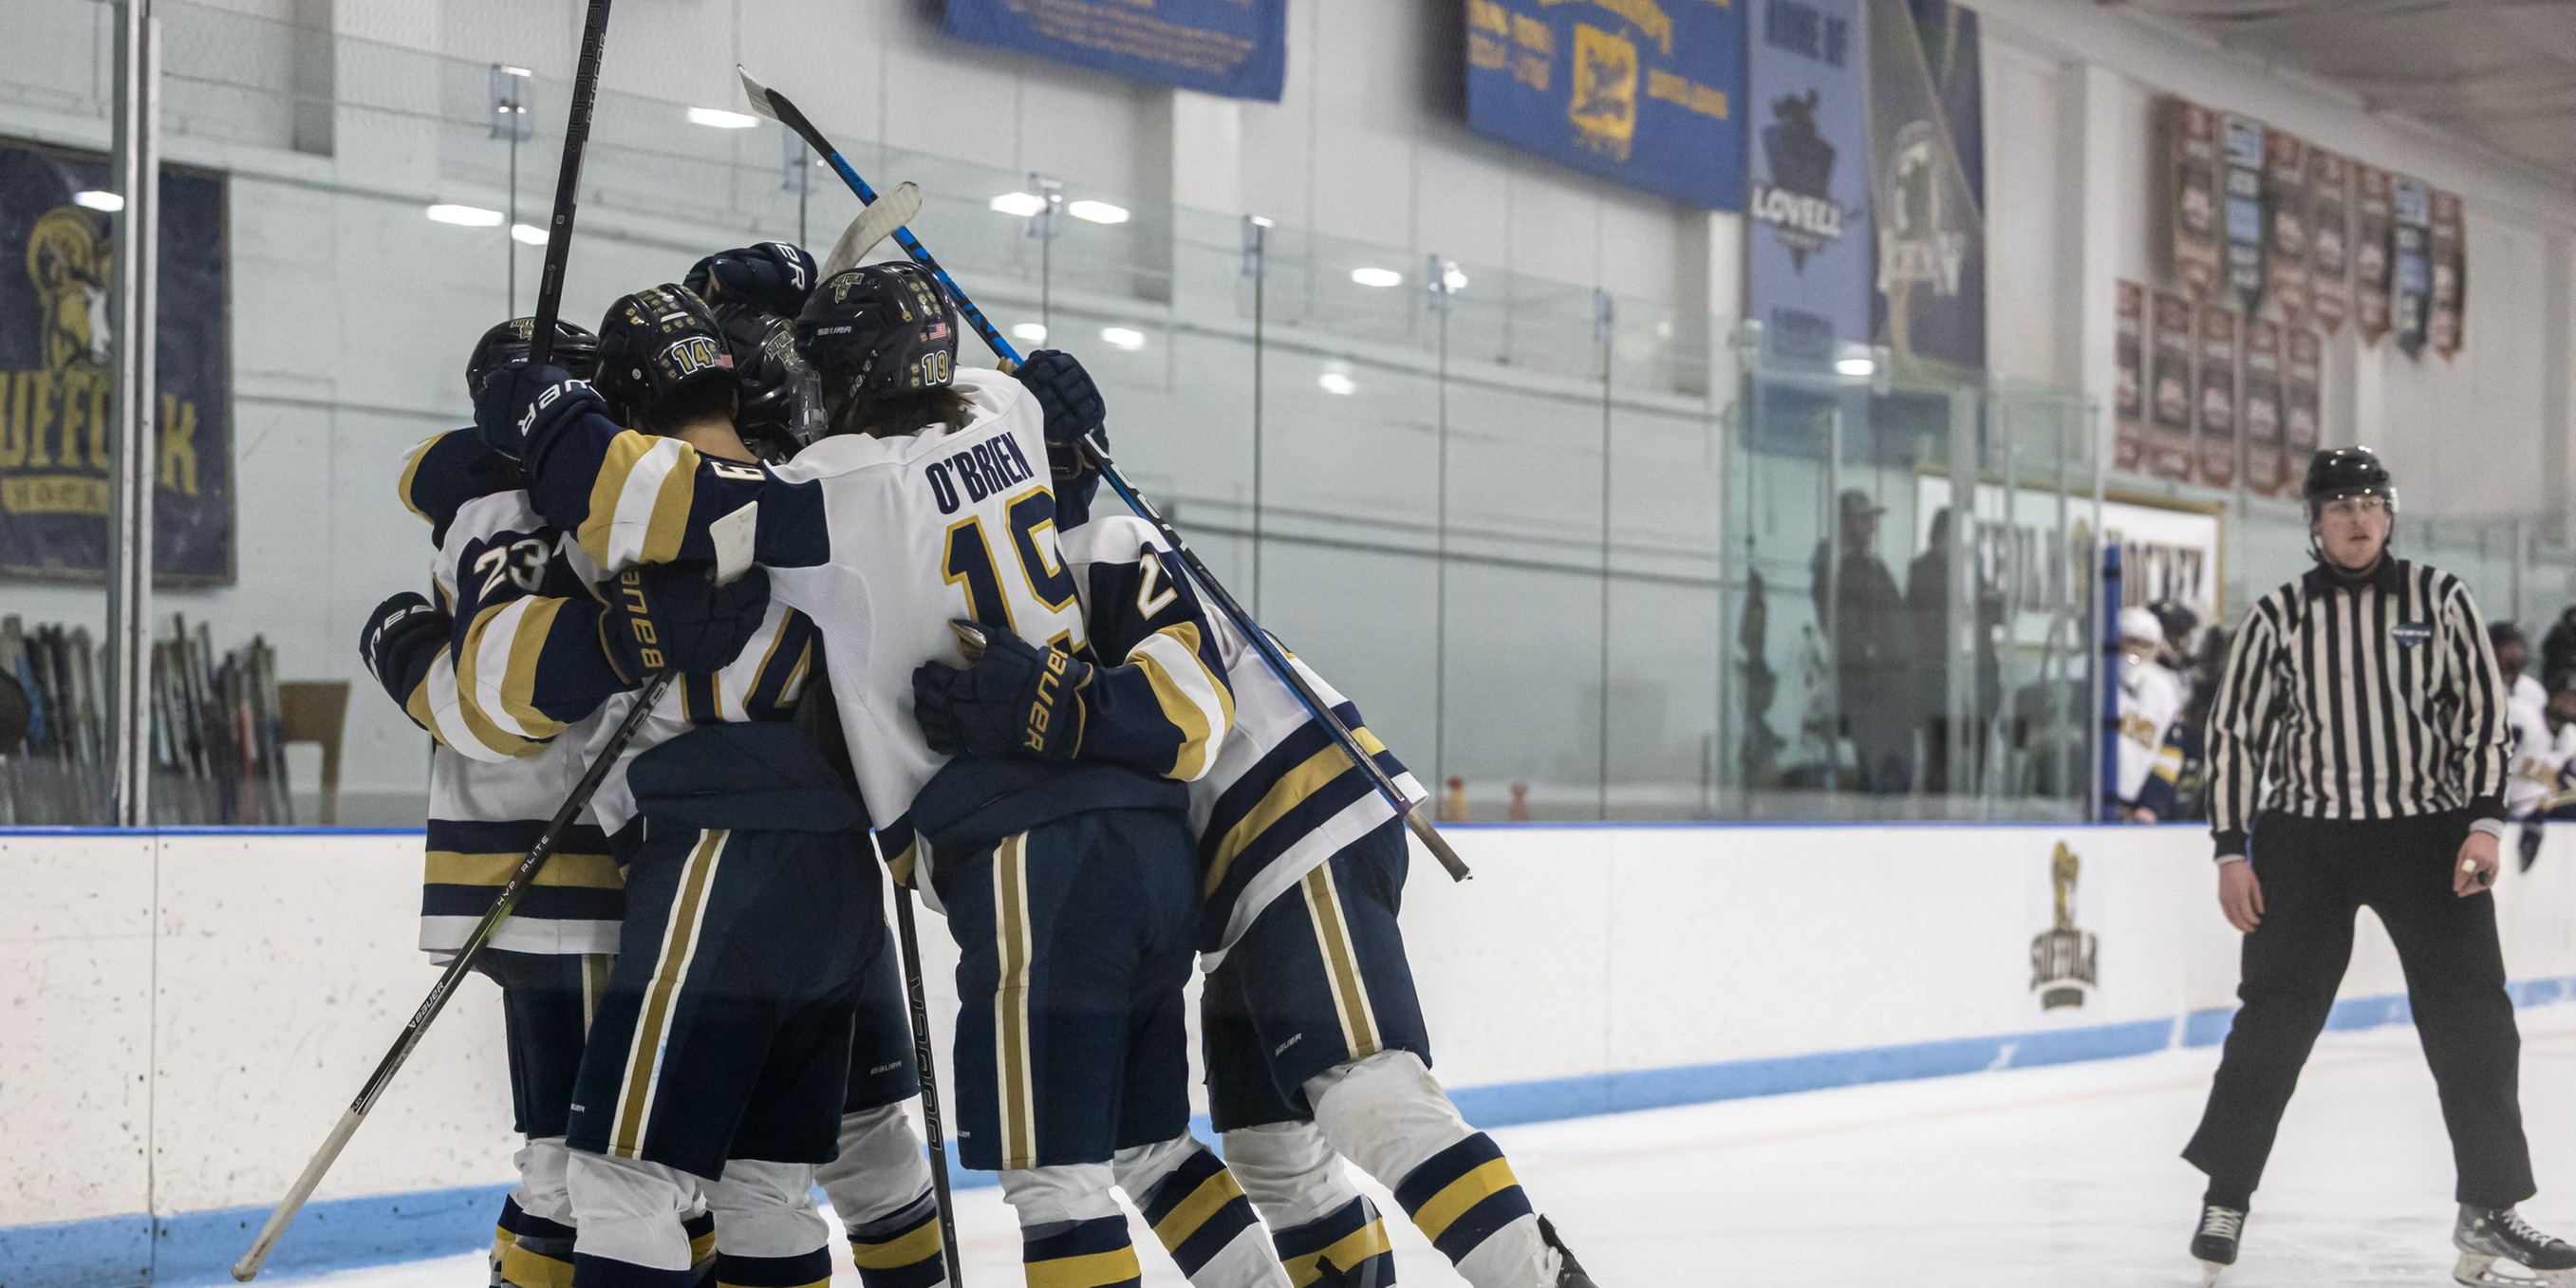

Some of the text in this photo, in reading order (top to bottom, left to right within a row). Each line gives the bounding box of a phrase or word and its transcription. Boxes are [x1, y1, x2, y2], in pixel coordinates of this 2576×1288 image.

[1750, 186, 1840, 238] LOVELL
[671, 339, 717, 375] 14
[922, 350, 948, 386] 19
[924, 431, 1035, 515] O'BRIEN
[474, 538, 550, 604] 23
[942, 484, 1088, 656] 19
[622, 570, 664, 668] BAUE
[415, 980, 446, 1024] BAUER
[869, 1059, 903, 1075] BAUER
